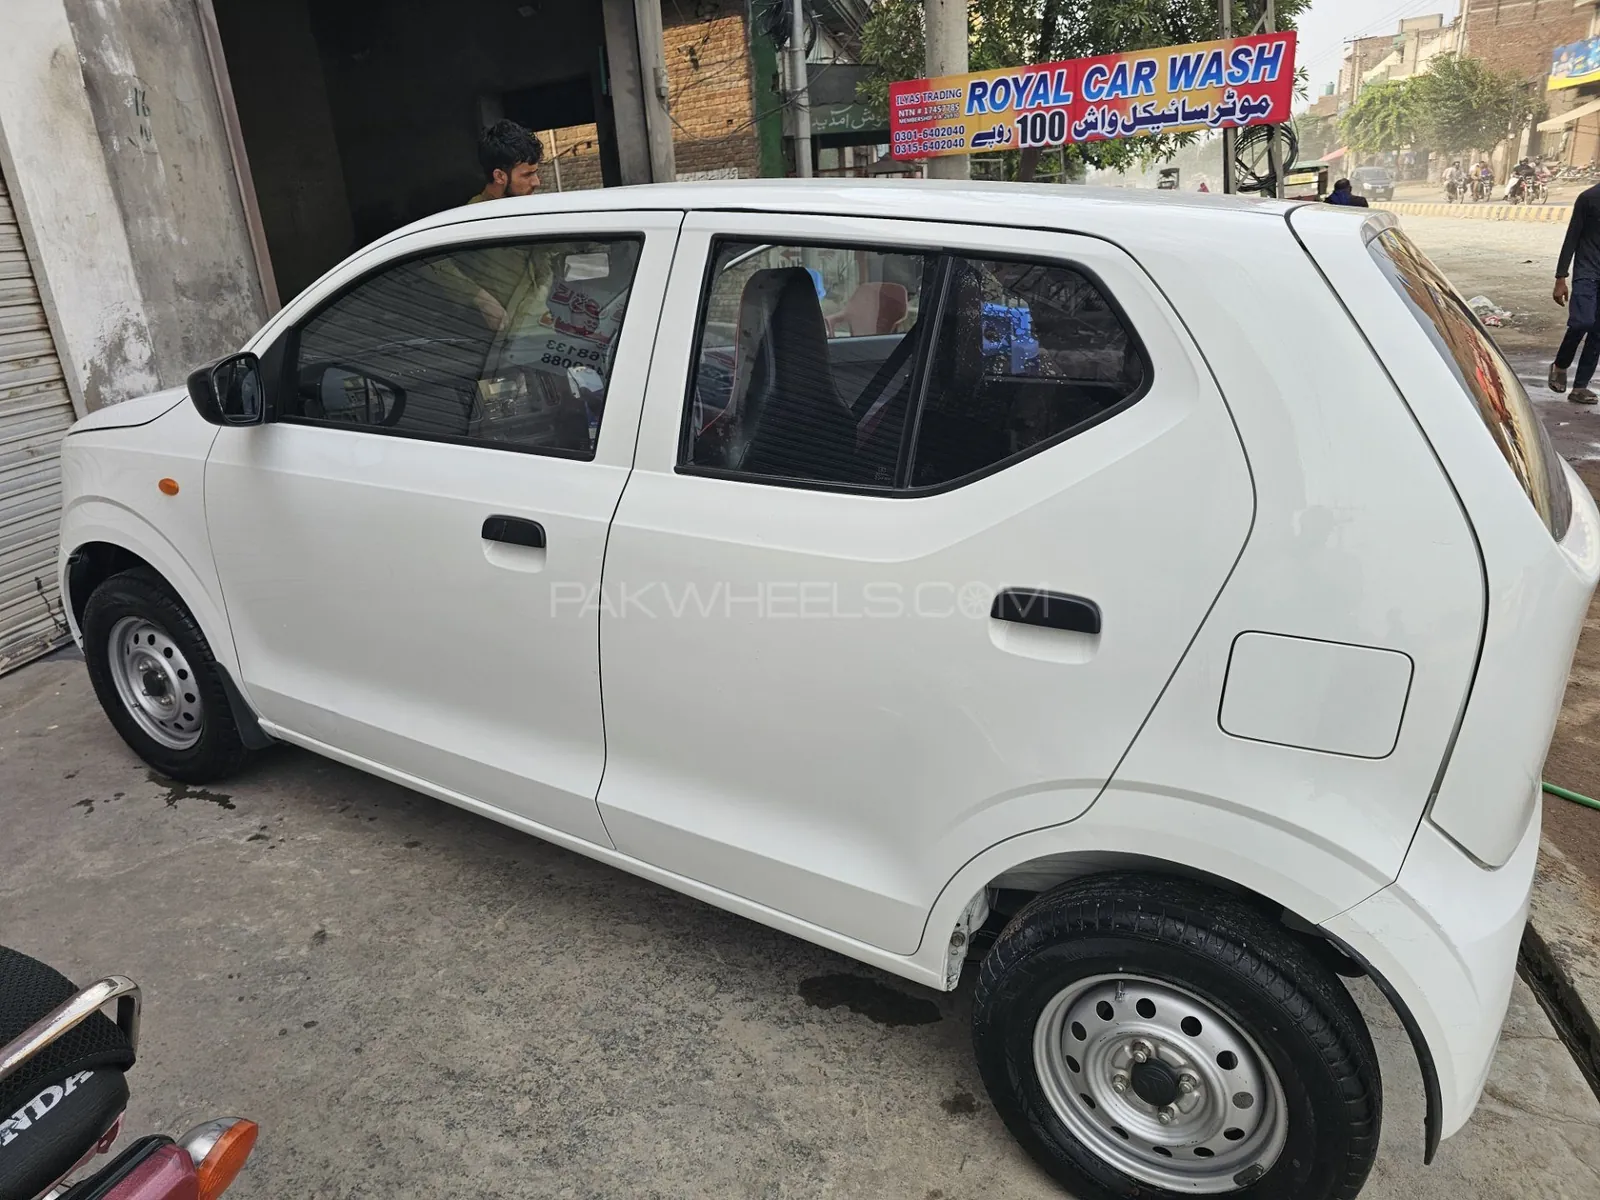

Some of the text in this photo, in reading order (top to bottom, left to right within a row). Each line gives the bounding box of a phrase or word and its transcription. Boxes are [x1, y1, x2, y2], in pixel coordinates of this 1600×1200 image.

[964, 41, 1286, 115] ROYAL CAR WASH
[896, 88, 962, 106] ILYAS TRADING
[894, 125, 965, 142] 0301-6402040
[970, 123, 1012, 148] روپے
[1016, 109, 1067, 147] 100
[1073, 105, 1119, 139] واش
[894, 138, 965, 155] 0315-6402040
[0, 1070, 94, 1146] NDA
